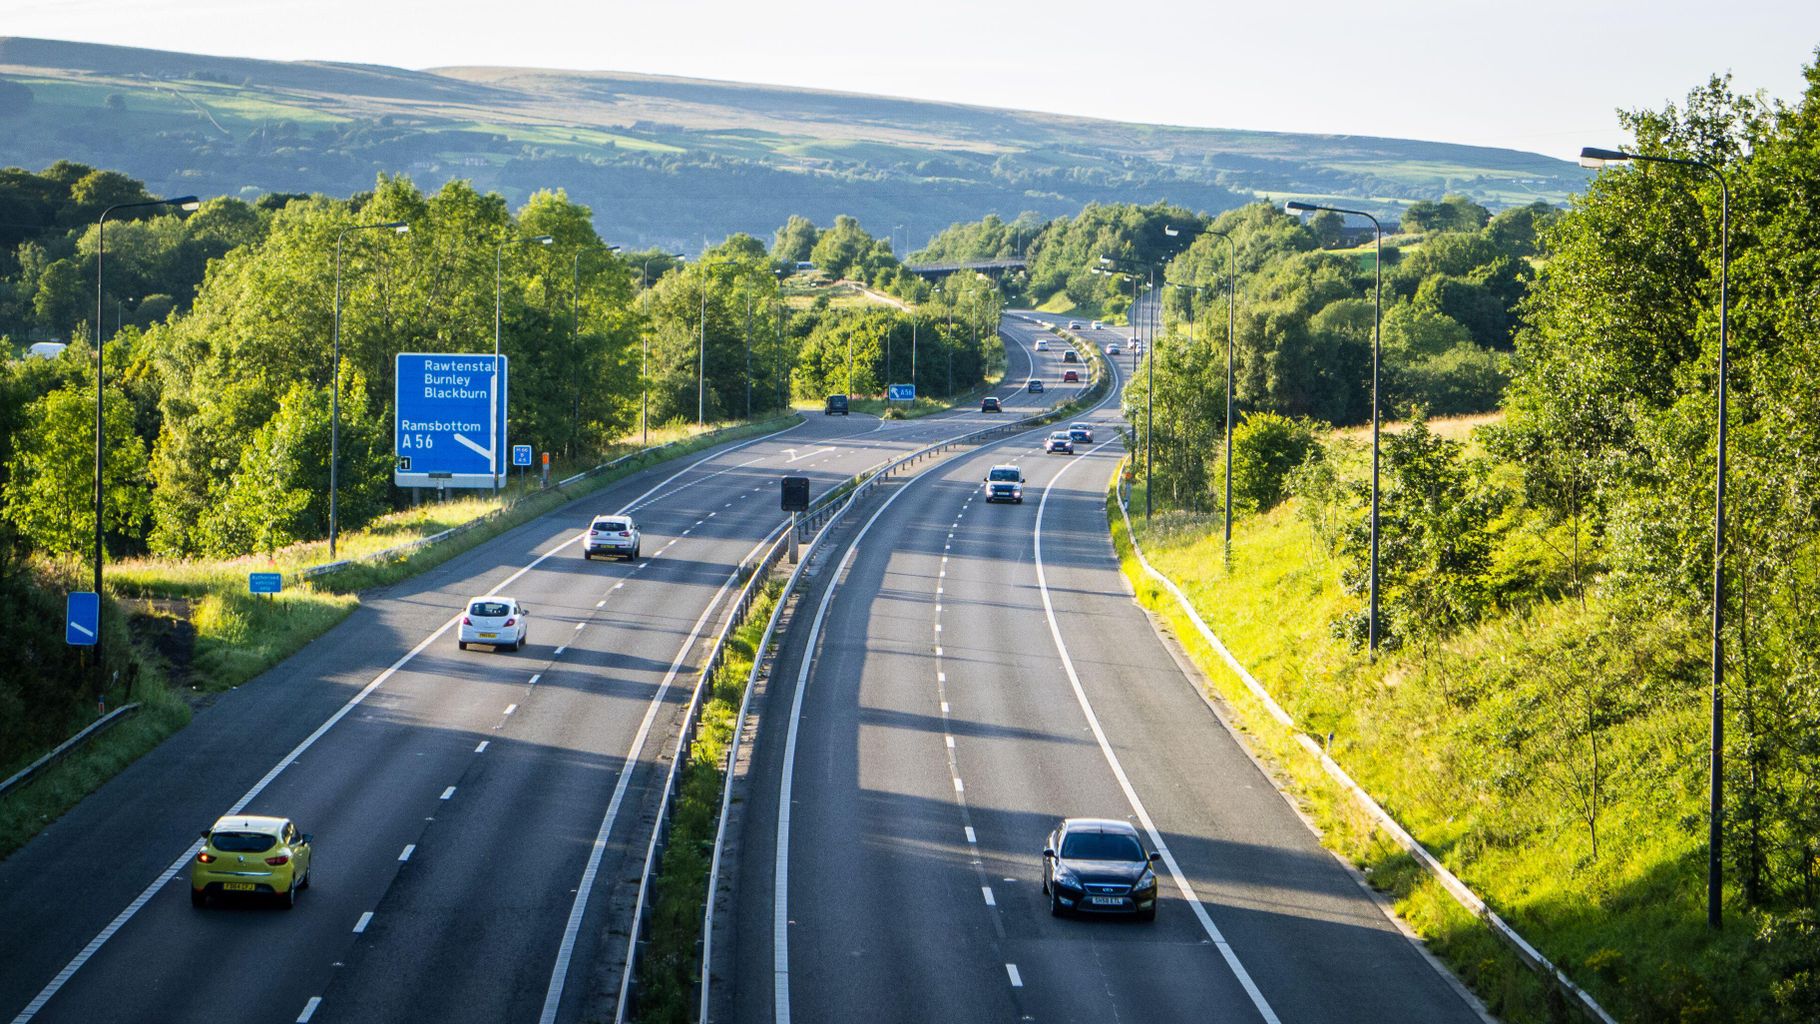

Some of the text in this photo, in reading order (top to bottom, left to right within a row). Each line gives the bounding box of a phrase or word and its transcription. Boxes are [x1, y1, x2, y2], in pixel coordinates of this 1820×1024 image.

[424, 360, 498, 372] Rawtenstal
[424, 373, 471, 387] Burnley
[424, 387, 487, 399] Blackburn
[900, 388, 912, 396] A56
[402, 420, 481, 432] Ramsbottom
